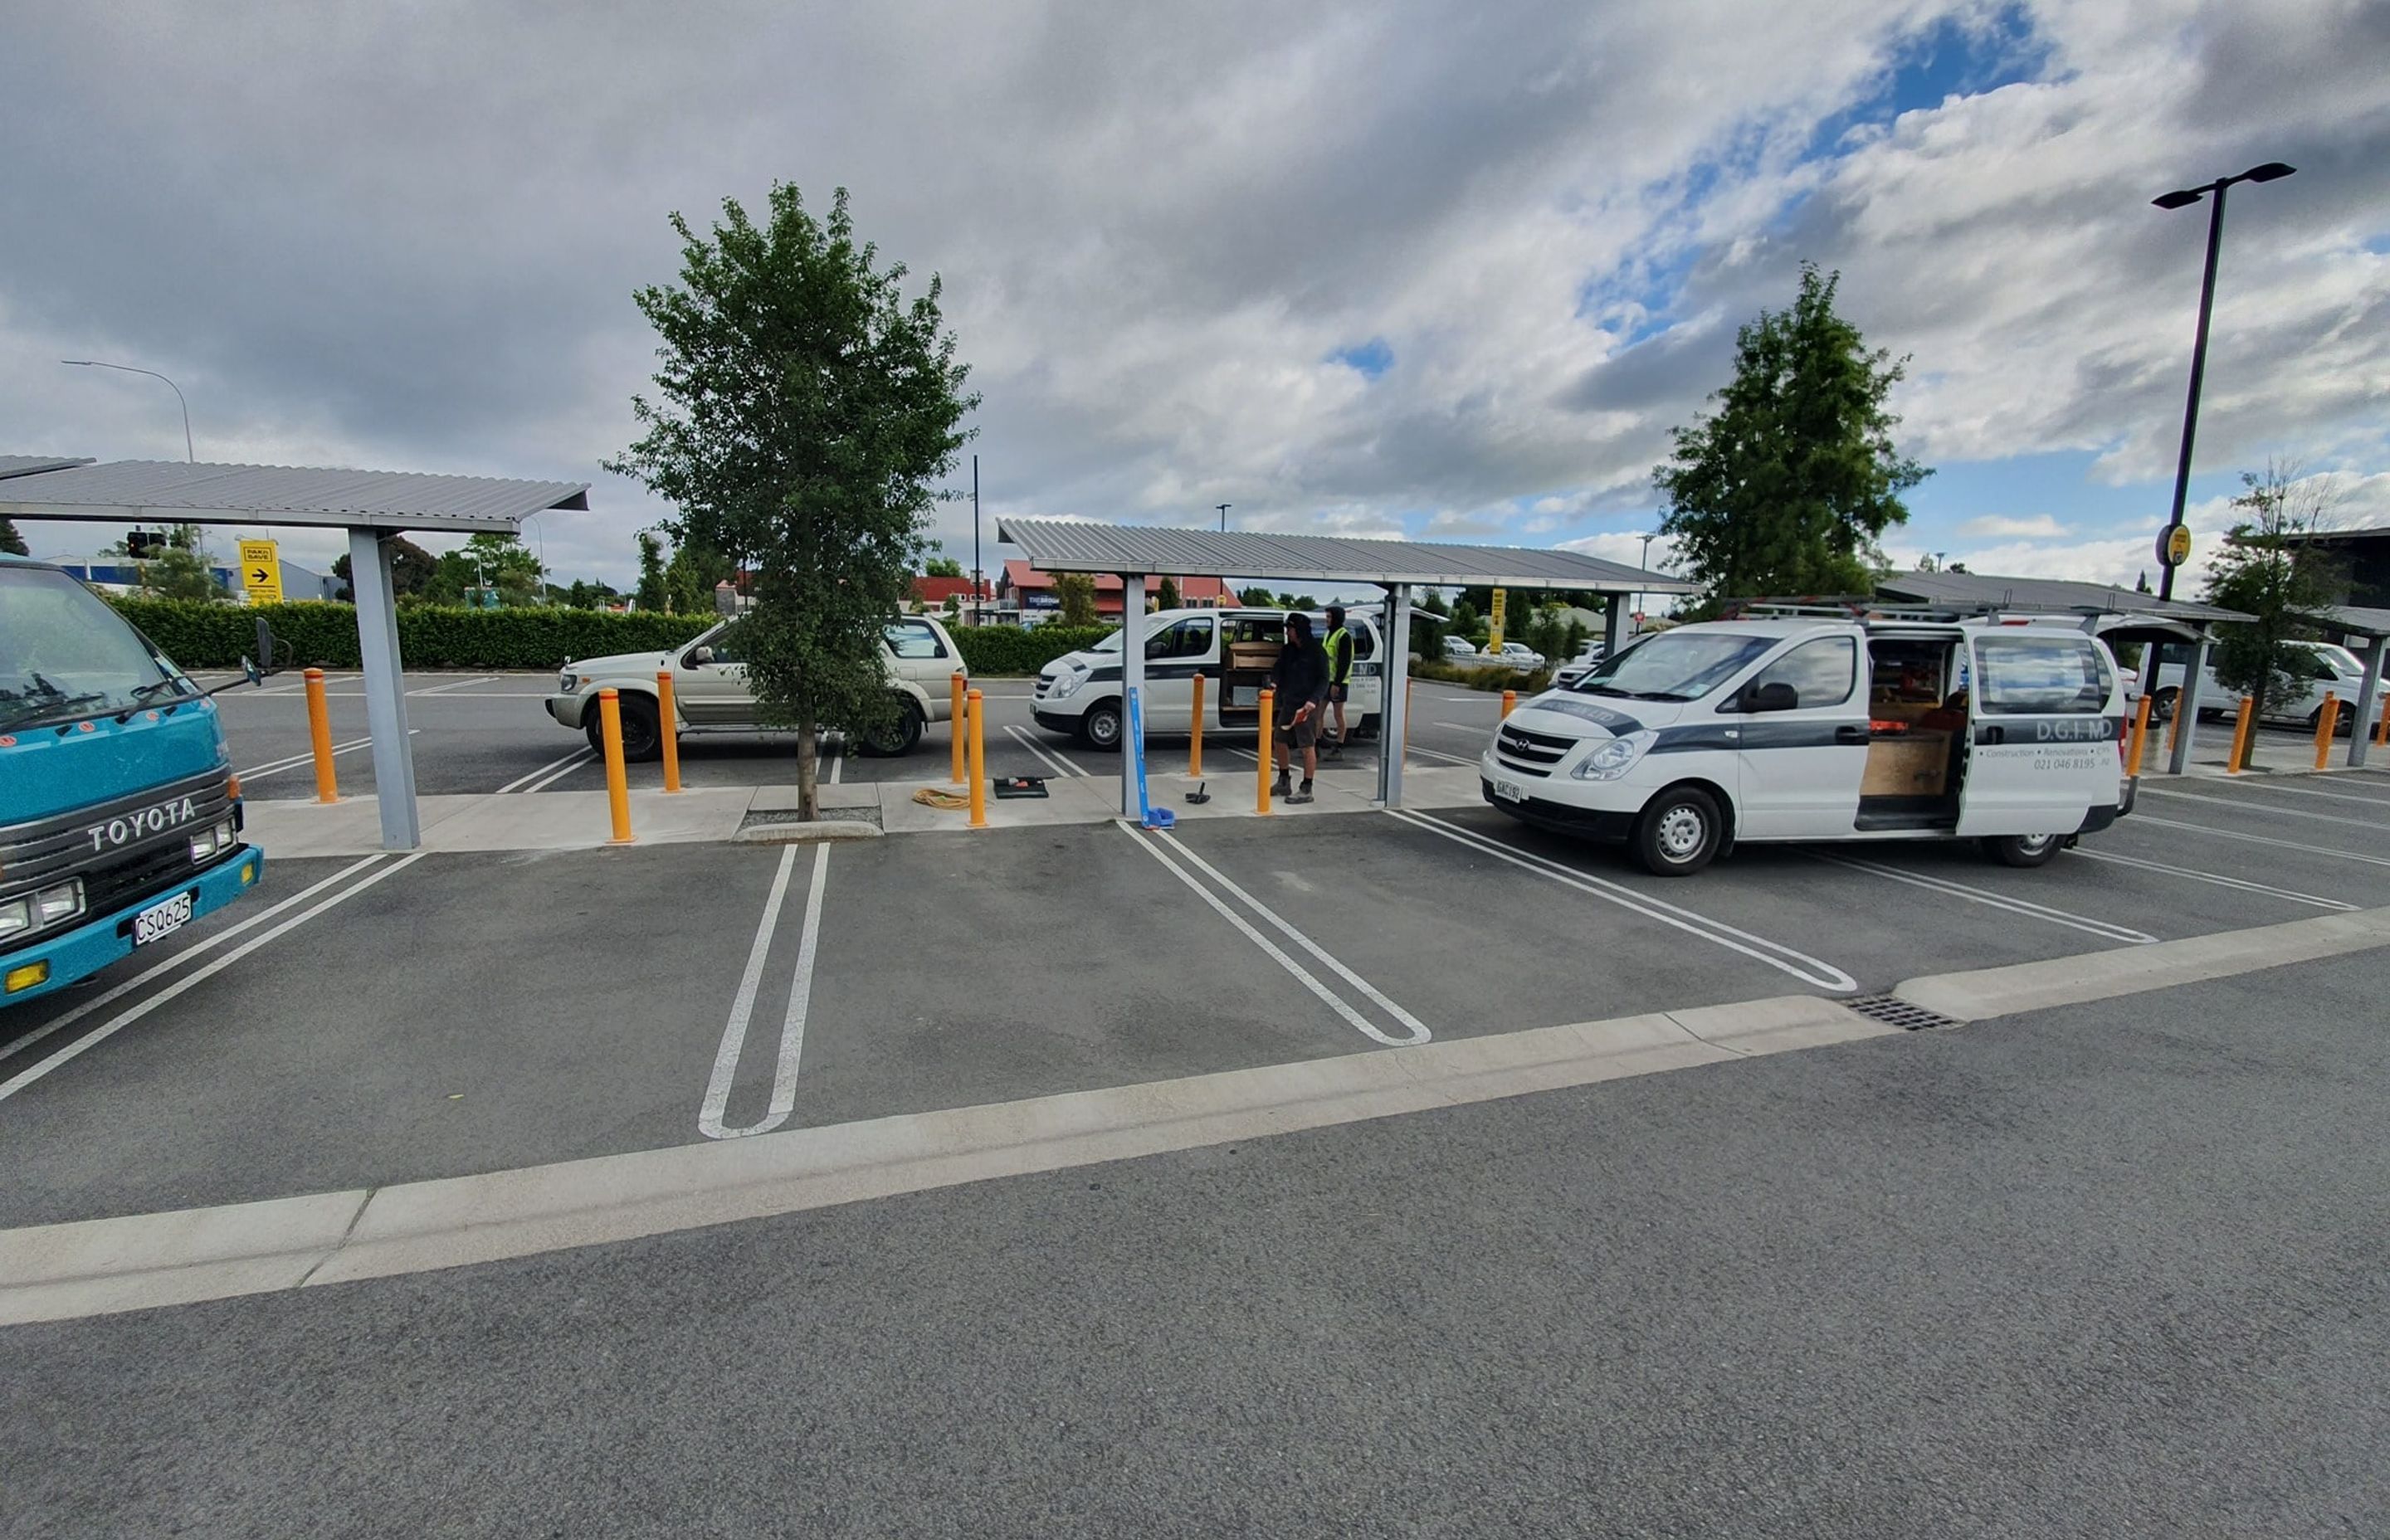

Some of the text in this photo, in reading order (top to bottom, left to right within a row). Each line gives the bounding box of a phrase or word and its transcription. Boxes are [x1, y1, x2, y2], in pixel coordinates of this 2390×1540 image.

[1986, 749, 2035, 758] Construction
[2043, 748, 2089, 757] Renovations
[2034, 758, 2051, 770] 021
[2053, 758, 2071, 769] 046
[2073, 758, 2095, 768] 8195
[88, 798, 195, 852] TOYOTA
[137, 897, 190, 941] CSQ625
